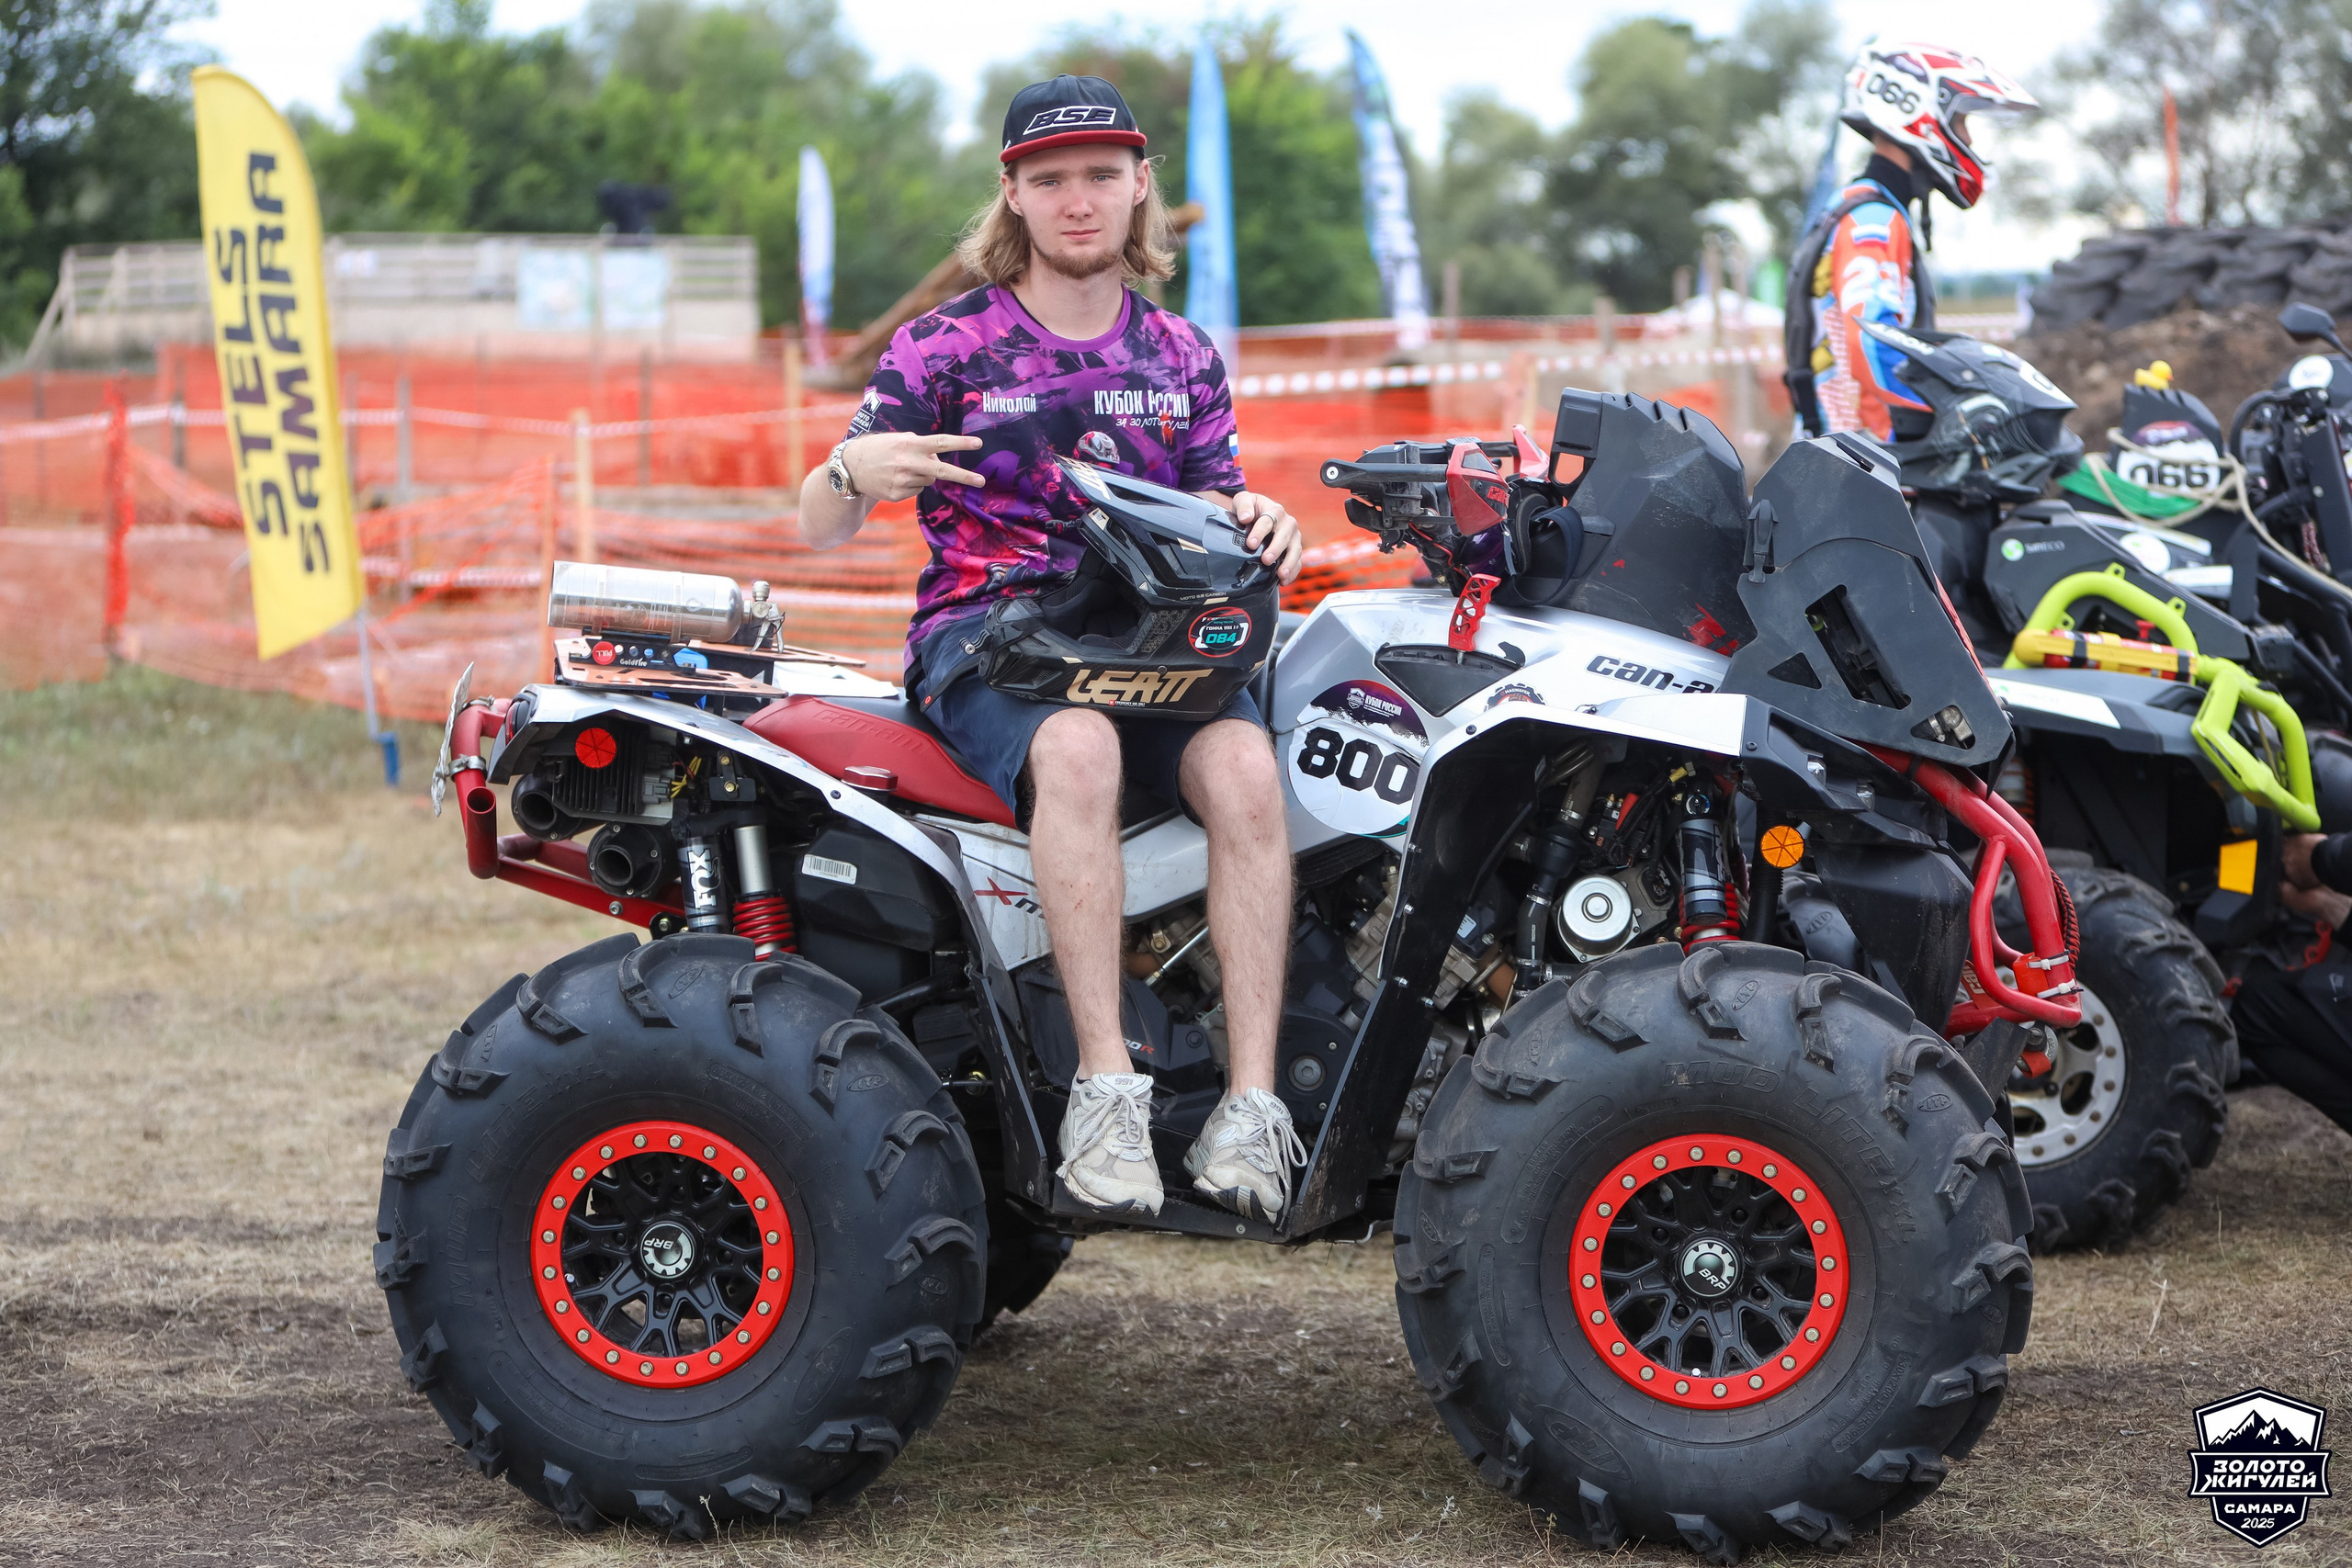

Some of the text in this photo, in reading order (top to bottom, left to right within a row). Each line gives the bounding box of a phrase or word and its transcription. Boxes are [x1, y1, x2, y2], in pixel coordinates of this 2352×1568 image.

[1867, 73, 1921, 114] 066
[1025, 107, 1114, 132] BSE
[246, 152, 331, 576] SAMARA
[214, 226, 288, 539] STELS
[982, 391, 1037, 413] Николай
[1093, 389, 1191, 418] КУБОК РССИИ
[595, 649, 613, 658] PULL
[1205, 632, 1238, 644] 084
[1066, 668, 1215, 705] LEATT
[1586, 654, 1717, 694] can-a
[1296, 726, 1421, 806] 800
[687, 849, 718, 909] FOX
[974, 875, 1045, 919] Xm
[1114, 1077, 1134, 1086] 991
[1269, 1100, 1284, 1115] 991
[1662, 1060, 1781, 1093] MUD
[1792, 1087, 1895, 1177] LITE
[643, 1235, 676, 1251] BRP
[1696, 1267, 1729, 1292] BRP
